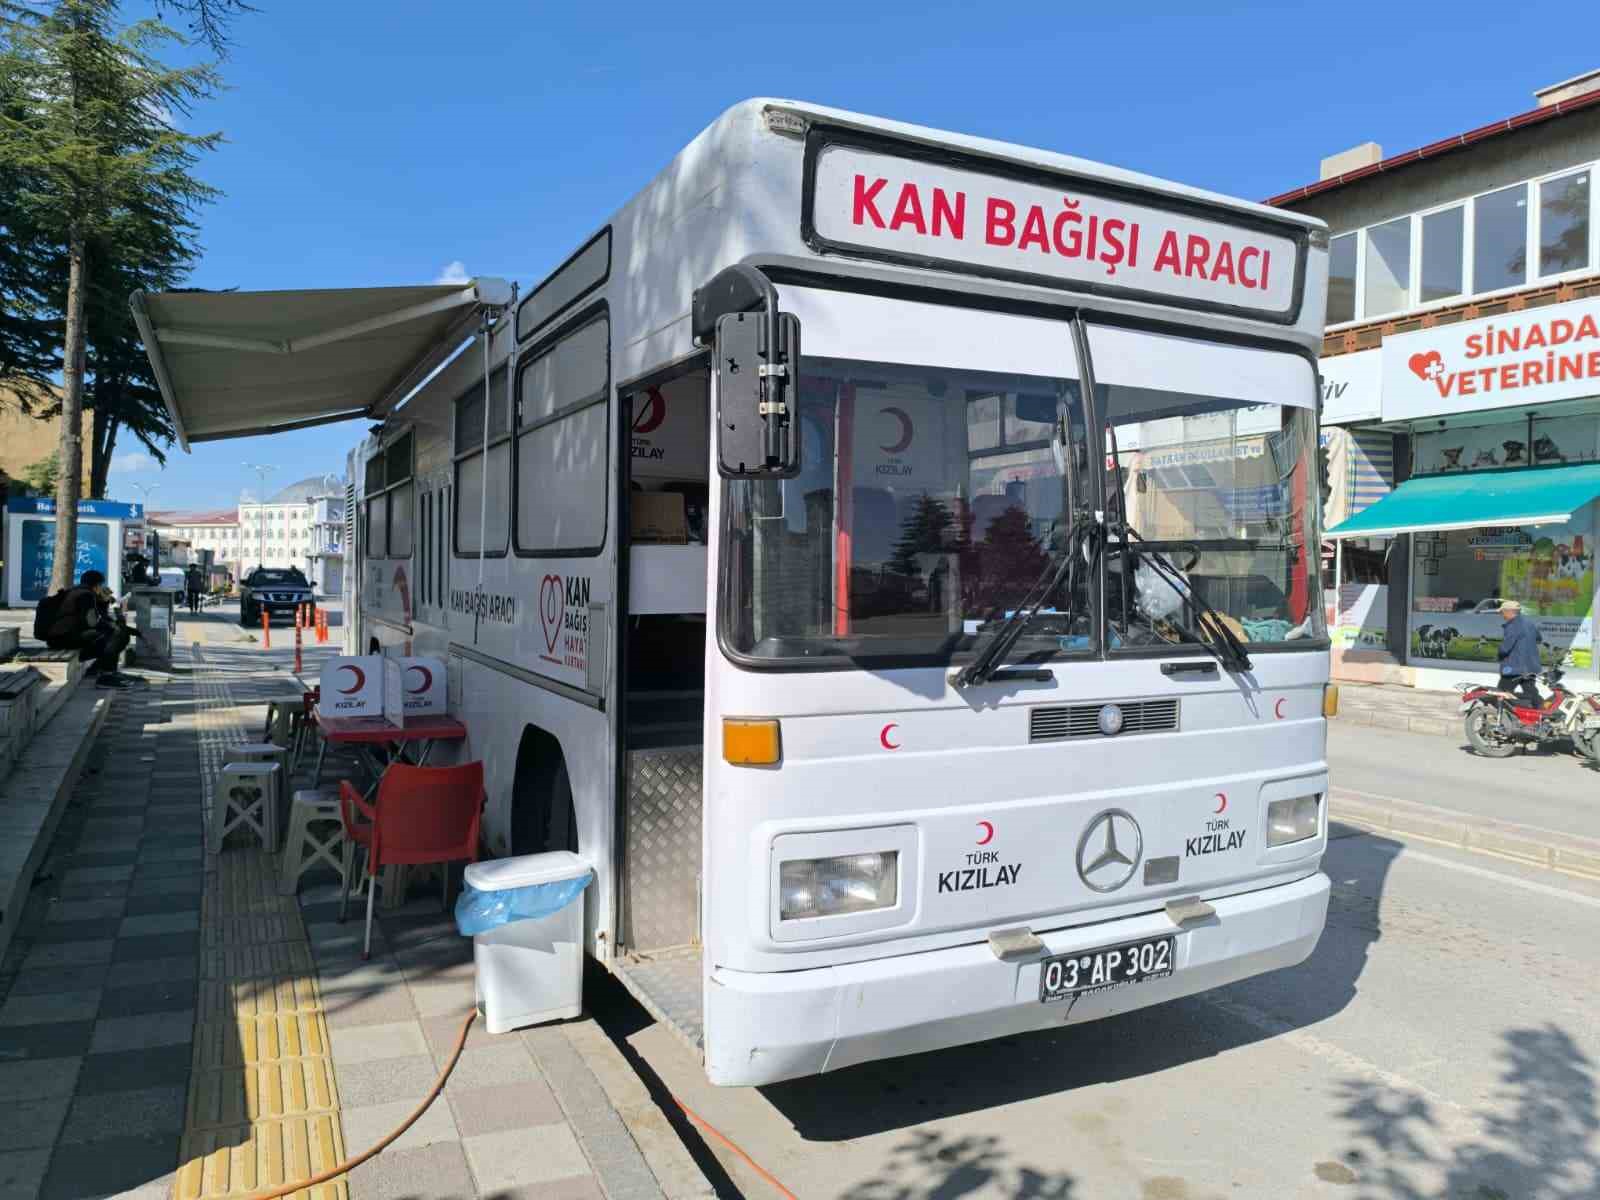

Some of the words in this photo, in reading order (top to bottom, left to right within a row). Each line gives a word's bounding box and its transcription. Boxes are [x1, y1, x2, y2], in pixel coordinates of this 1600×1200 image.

[851, 174, 967, 241] KAN
[984, 197, 1141, 276] BAĞIŞI
[1153, 230, 1271, 290] ARACI
[1464, 313, 1600, 360] SİNADA
[1435, 350, 1600, 399] VETERİNE
[565, 576, 591, 608] KAN
[489, 594, 515, 625] ARACI
[565, 609, 588, 637] BAĞIŞ
[1205, 818, 1230, 832] TÜRK
[965, 850, 1000, 865] TÜRK
[1185, 829, 1247, 857] KIZILAY
[937, 863, 1022, 894] KIZILAY
[1045, 959, 1079, 991] 03
[1091, 951, 1122, 984] AP
[1126, 940, 1169, 976] 302
